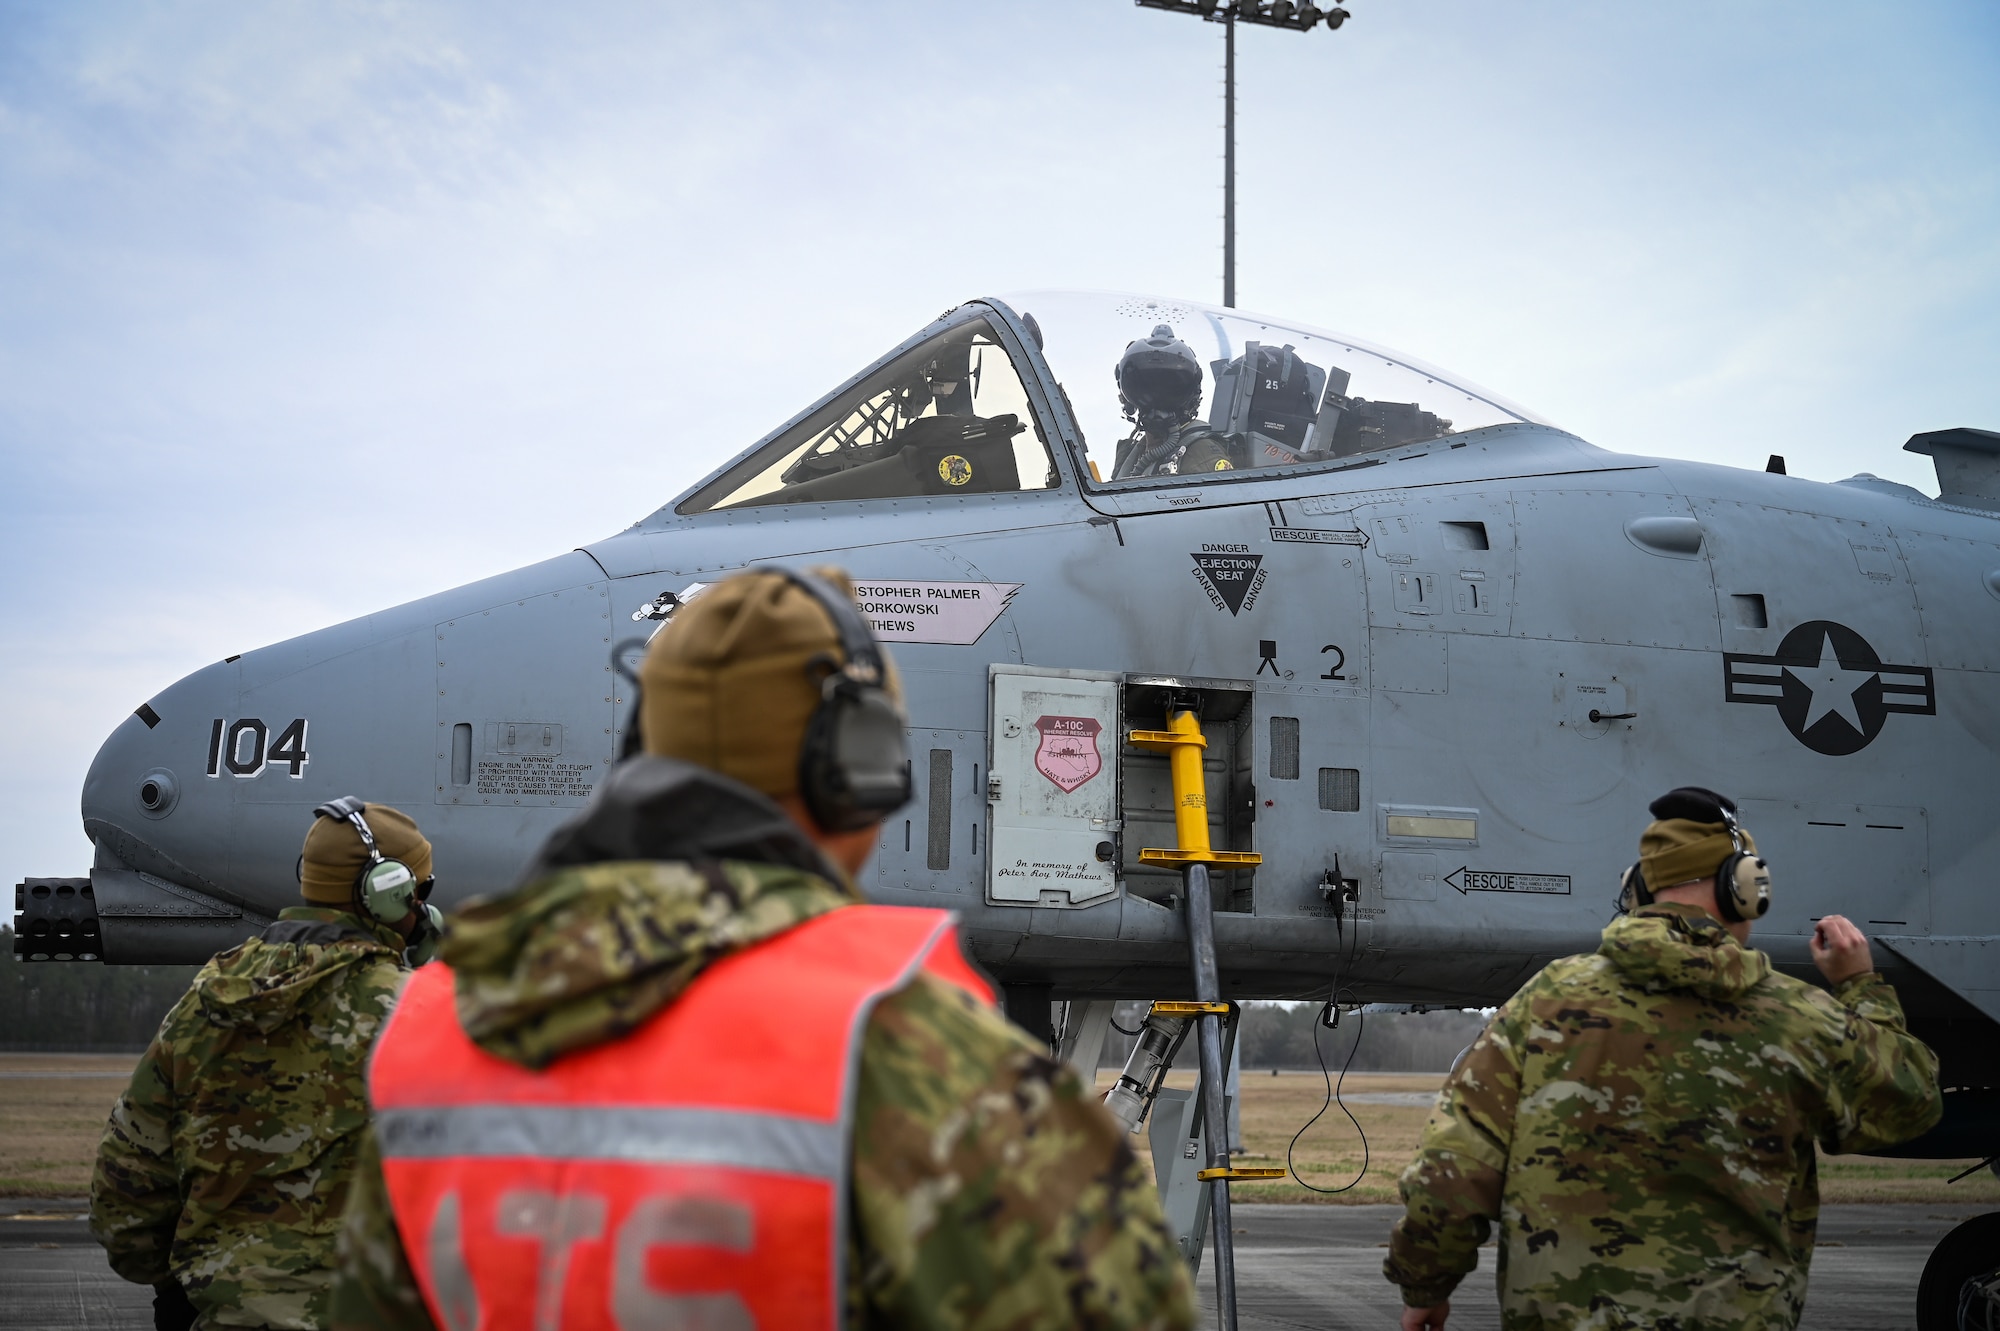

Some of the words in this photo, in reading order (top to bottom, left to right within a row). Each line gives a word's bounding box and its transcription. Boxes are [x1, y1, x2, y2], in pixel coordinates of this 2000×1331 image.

[1266, 380, 1278, 390] 25
[1170, 497, 1201, 506] 90104
[1274, 530, 1320, 540] RESCUE
[1202, 544, 1249, 552] DANGER
[1200, 558, 1256, 570] EJECTION
[1216, 570, 1244, 580] SEAT
[850, 586, 921, 598] ISTOPHER
[928, 588, 980, 600] PALMER
[1192, 567, 1226, 612] DANGER
[1242, 568, 1268, 612] DANGER
[1054, 720, 1084, 730] A-10C
[207, 719, 309, 779] 104
[1044, 767, 1060, 781] HATE
[1066, 770, 1091, 783] WHISKY
[1016, 859, 1028, 867] In
[1032, 862, 1073, 871] memory
[1076, 863, 1088, 872] of
[998, 868, 1026, 877] Peter
[1030, 869, 1051, 879] Roy
[1055, 870, 1102, 880] Mathews
[1464, 874, 1515, 889] RESCUE
